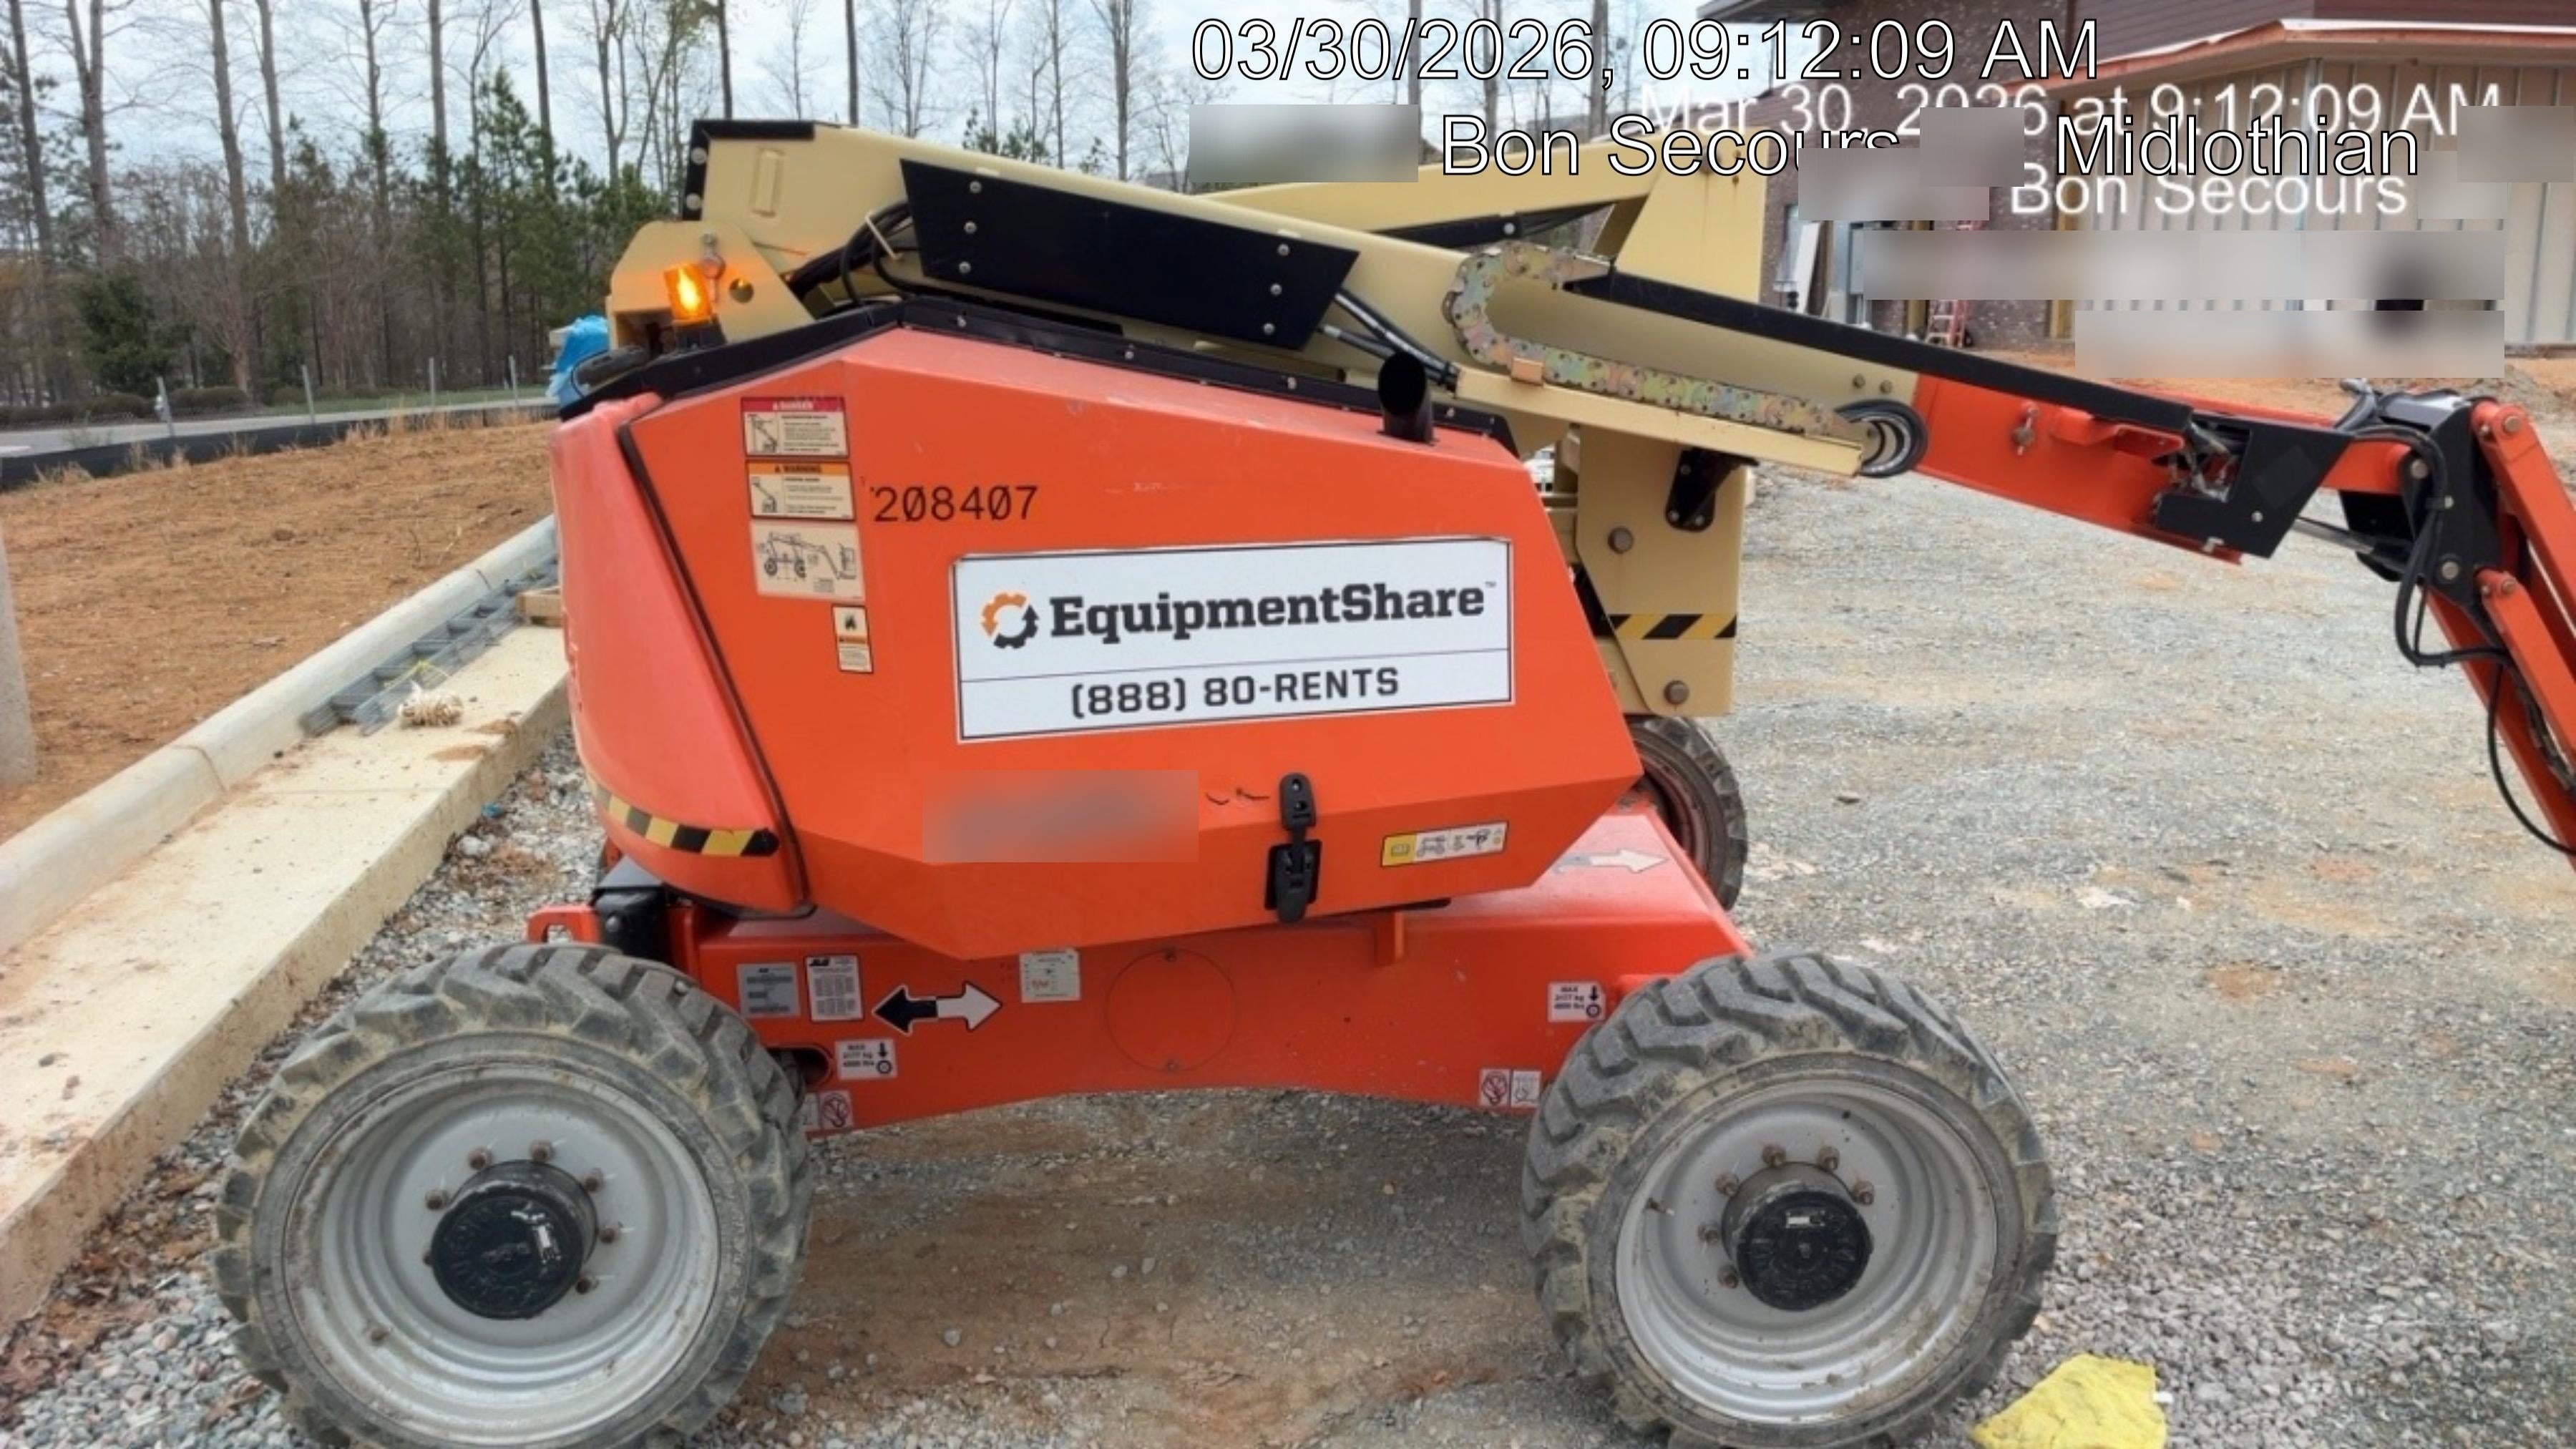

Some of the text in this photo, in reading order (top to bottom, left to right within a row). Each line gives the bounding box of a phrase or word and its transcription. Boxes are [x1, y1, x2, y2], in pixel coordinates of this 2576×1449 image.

[874, 485, 1038, 522] 208407
[1071, 667, 1400, 719] (888) 80-RENTS
